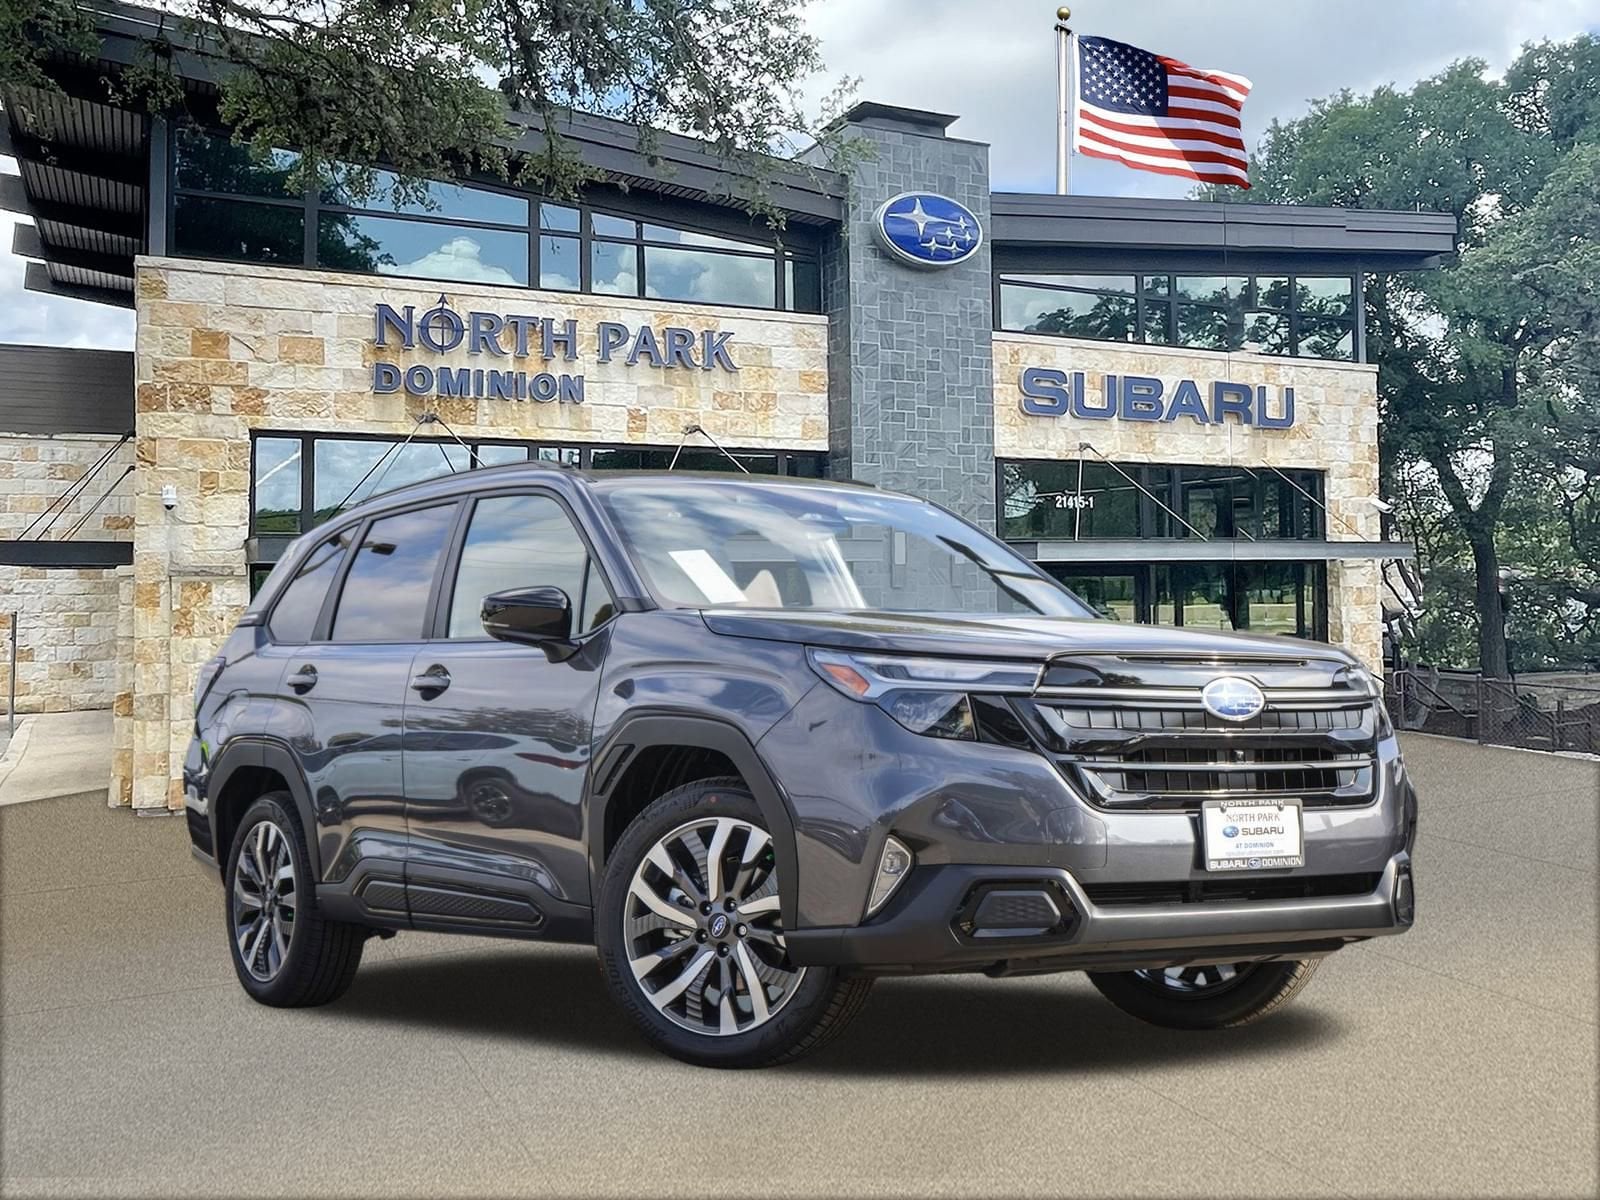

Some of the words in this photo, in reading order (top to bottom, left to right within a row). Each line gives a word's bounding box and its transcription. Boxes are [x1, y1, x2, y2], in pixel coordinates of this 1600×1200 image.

[374, 293, 579, 361] NORTH
[597, 320, 742, 373] PARK
[372, 362, 585, 404] DOMINION
[1018, 367, 1294, 430] SUBARU
[1258, 799, 1285, 807] PARK
[1226, 813, 1255, 822] NORTH
[1257, 812, 1281, 822] PARK
[1241, 826, 1285, 836] SUBARU
[1210, 859, 1248, 869] SUBARU
[1262, 857, 1302, 867] DOMINION
